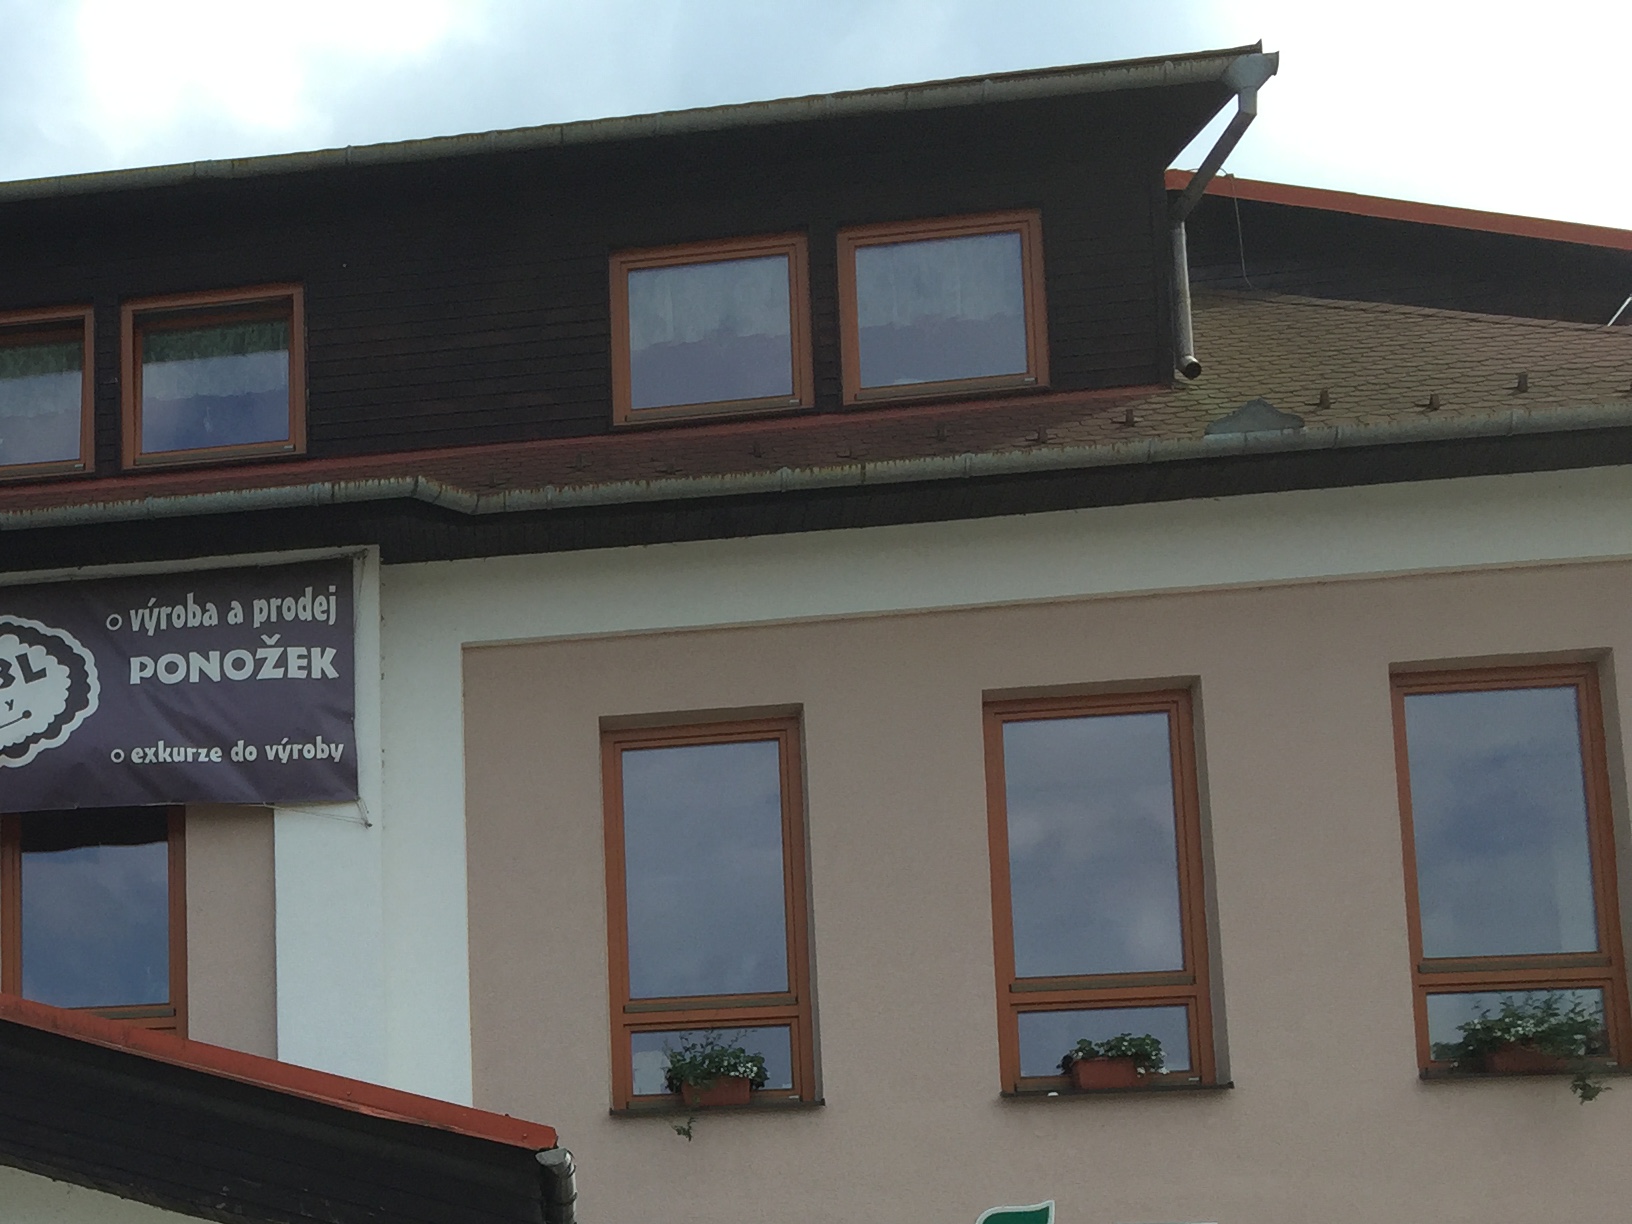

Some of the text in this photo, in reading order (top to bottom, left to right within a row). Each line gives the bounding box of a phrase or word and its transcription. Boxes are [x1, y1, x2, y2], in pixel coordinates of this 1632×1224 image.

[129, 586, 336, 635] výroba a prodej
[129, 634, 339, 685] PONOŽEK
[130, 737, 344, 765] exkurze do výroby
